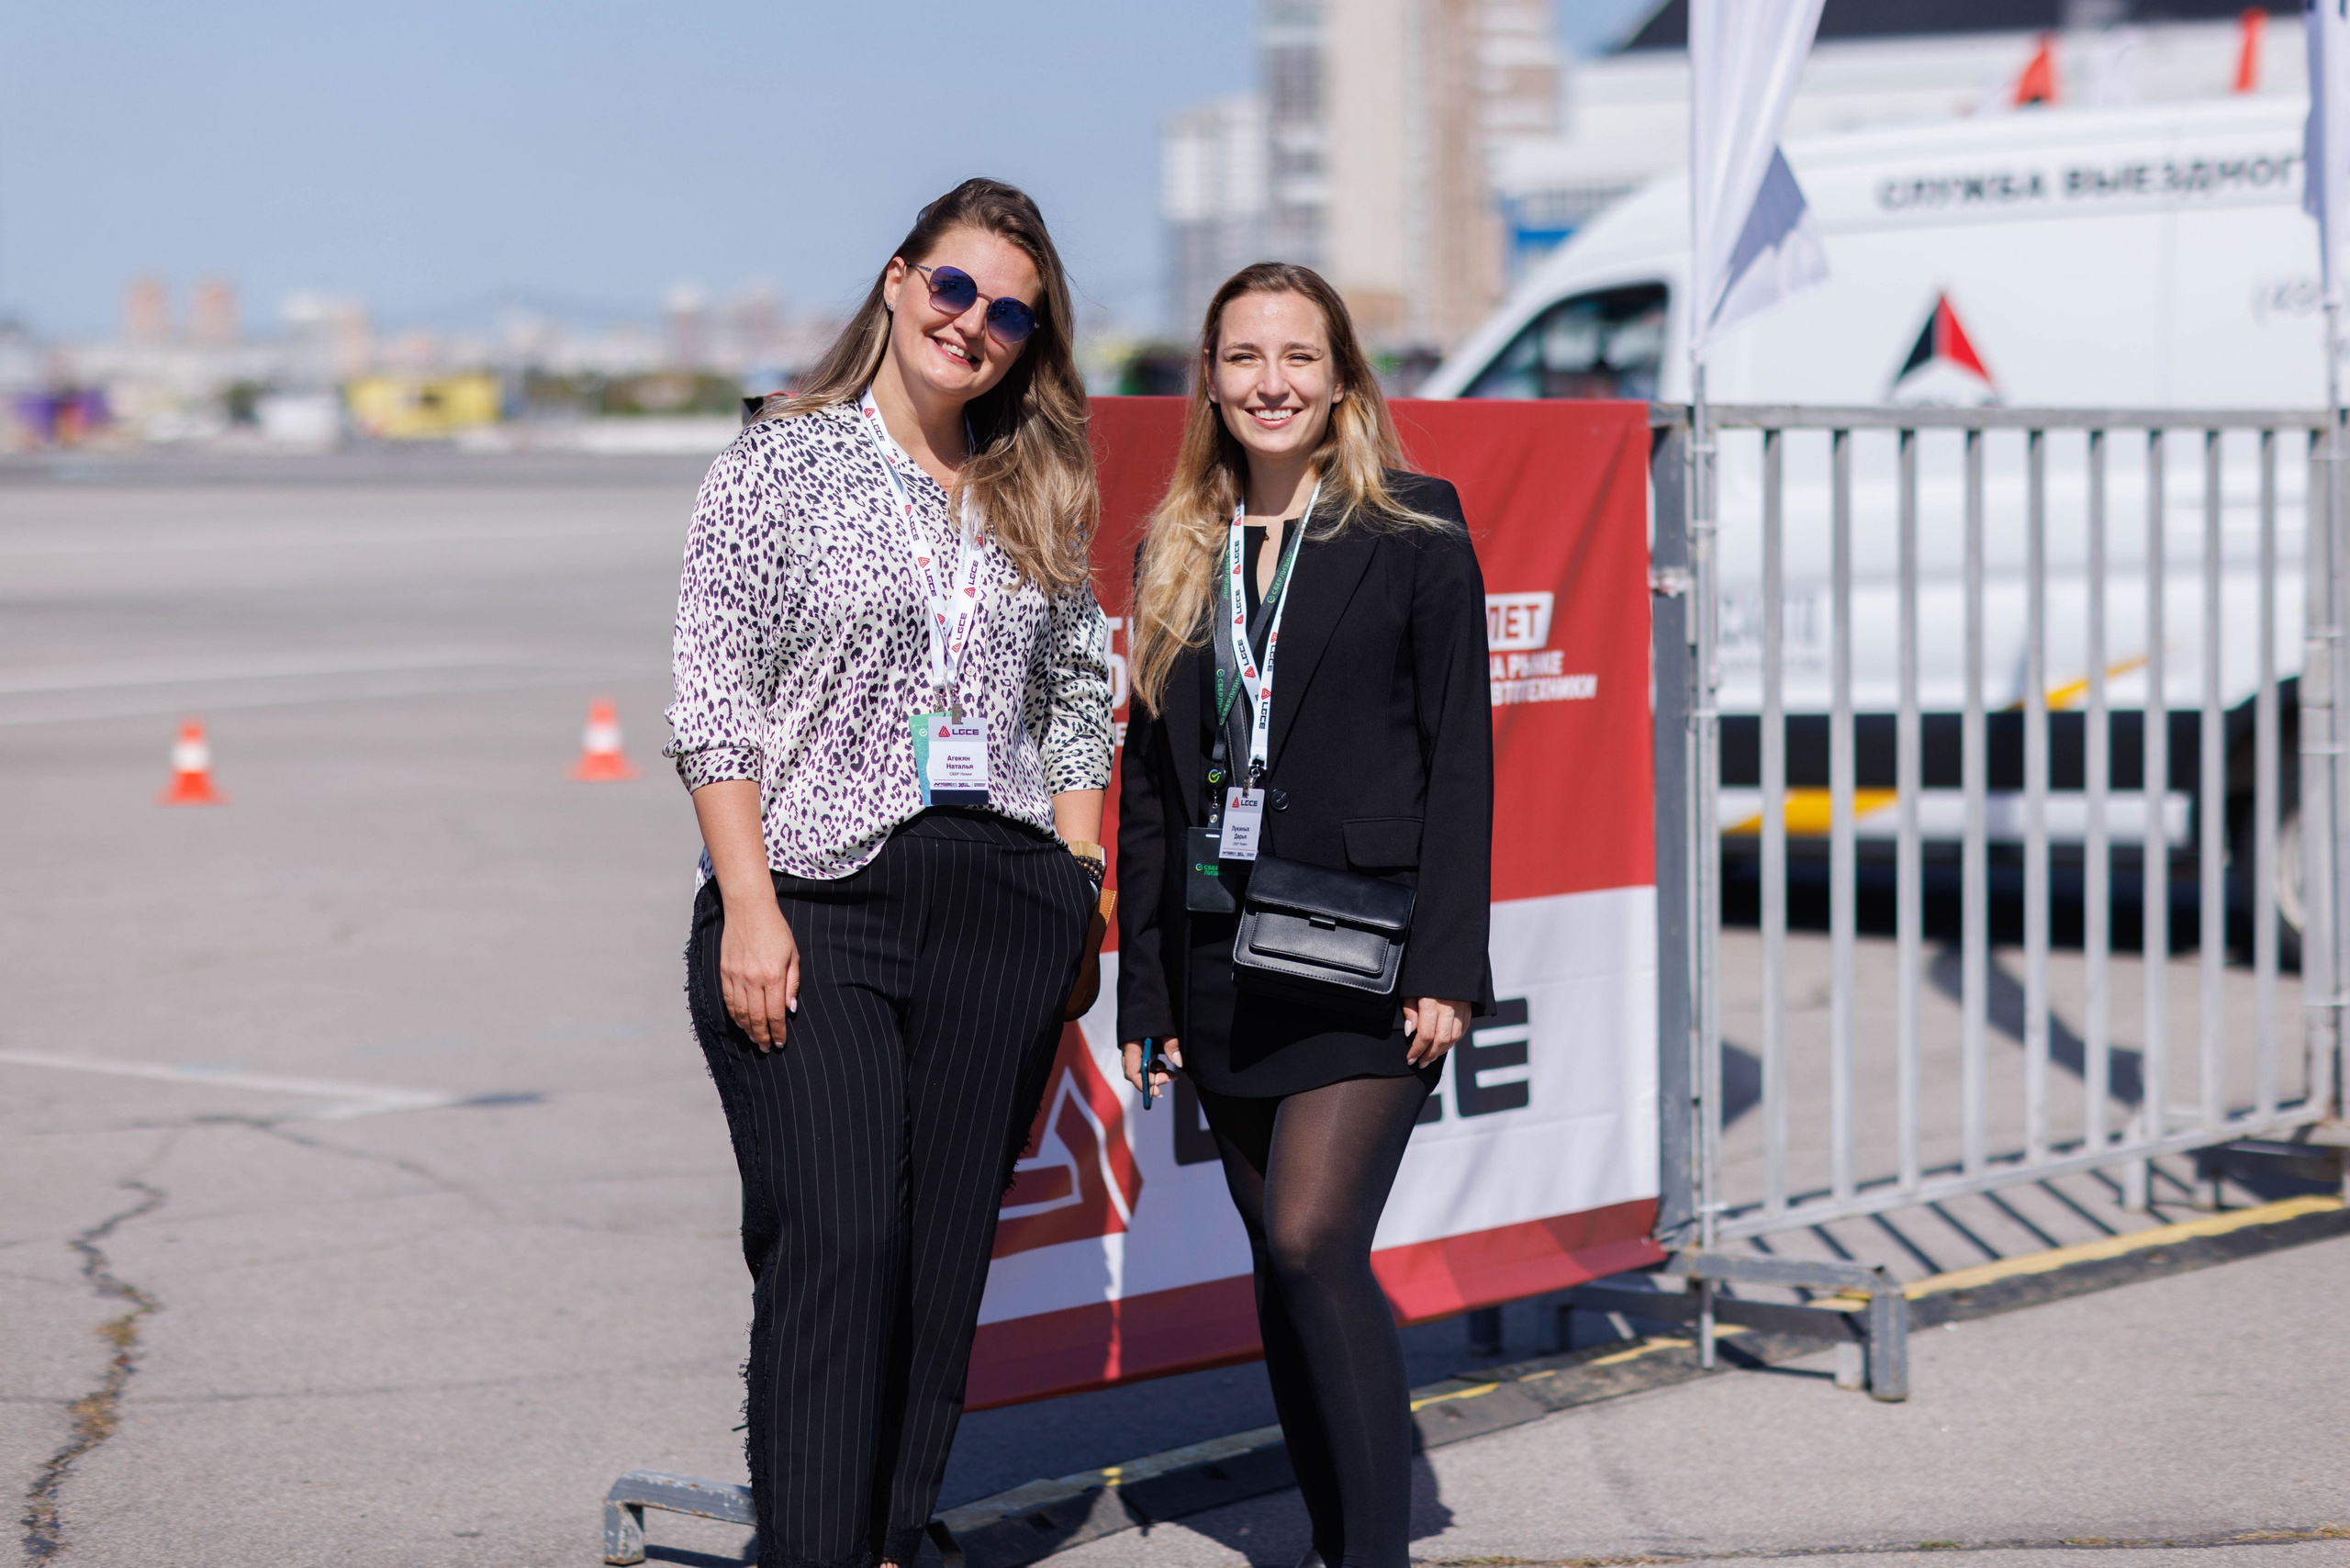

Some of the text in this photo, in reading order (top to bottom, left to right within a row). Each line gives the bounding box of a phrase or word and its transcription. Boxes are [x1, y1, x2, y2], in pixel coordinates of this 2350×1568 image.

[1881, 154, 2301, 209] СЛУЖБА ВЫЕЗДНОГ
[909, 515, 920, 542] LGCE
[924, 568, 937, 597] LGCE
[968, 559, 979, 586] LGCE
[956, 612, 968, 641] LGCE
[1237, 639, 1249, 666] LGCE
[1259, 701, 1269, 730] LGCE
